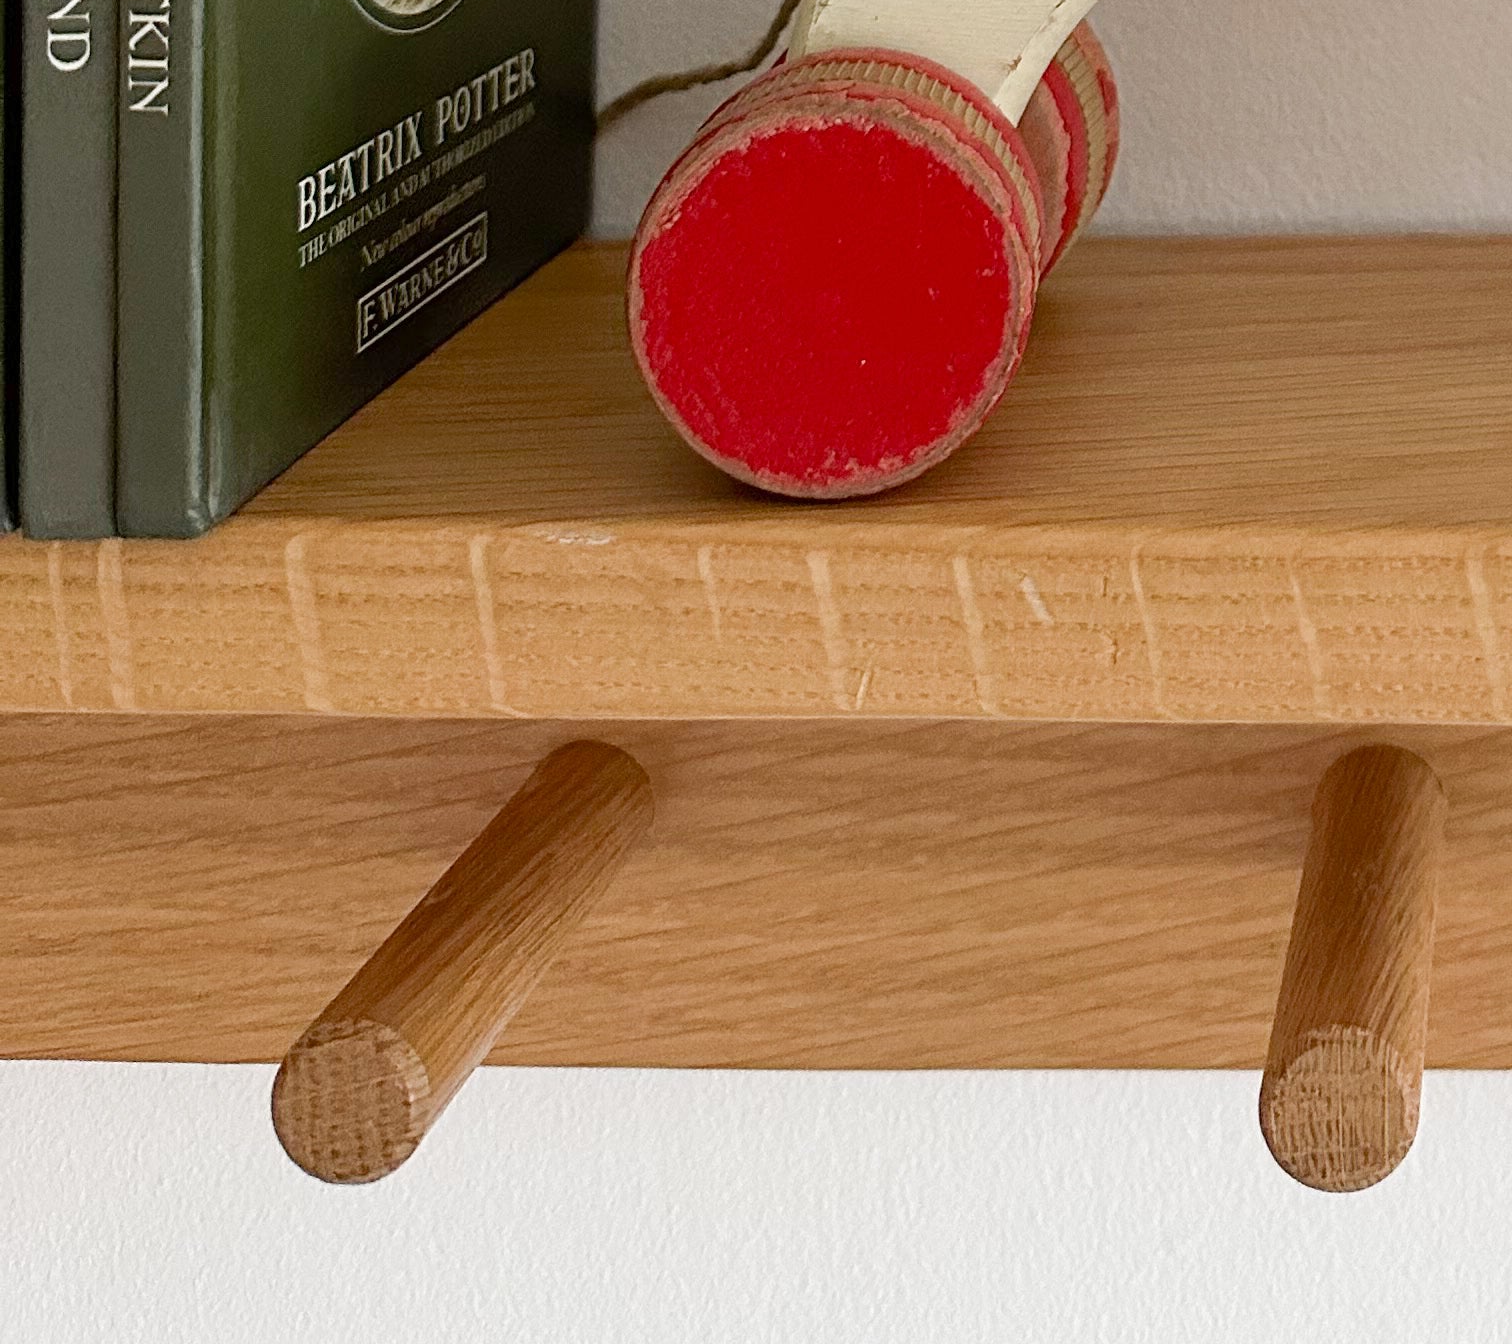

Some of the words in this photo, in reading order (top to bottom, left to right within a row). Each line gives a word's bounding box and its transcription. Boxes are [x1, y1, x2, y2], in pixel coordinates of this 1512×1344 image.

[298, 112, 422, 233] BEATRIX
[436, 47, 537, 145] POTTER
[299, 231, 327, 268] THE
[329, 192, 389, 248] ORIGINAL
[364, 300, 378, 339] F.
[379, 255, 444, 320] WARNE
